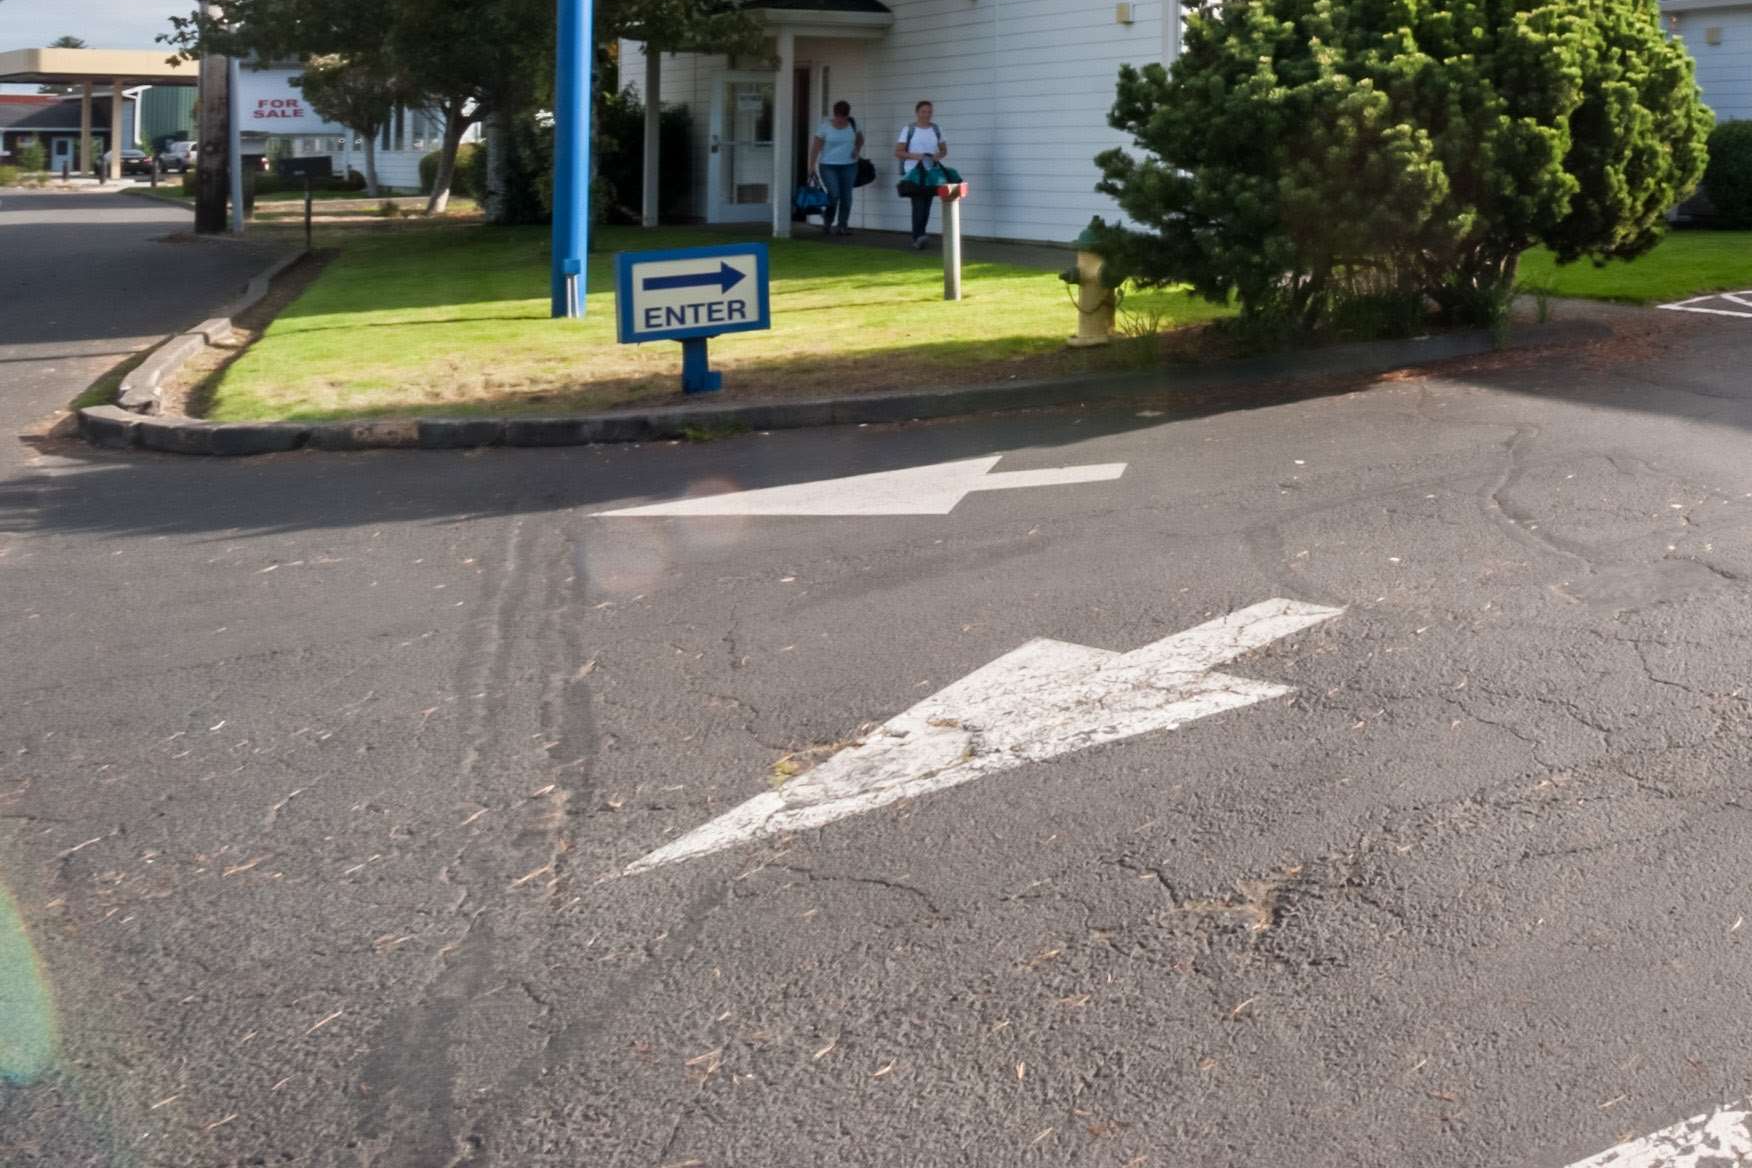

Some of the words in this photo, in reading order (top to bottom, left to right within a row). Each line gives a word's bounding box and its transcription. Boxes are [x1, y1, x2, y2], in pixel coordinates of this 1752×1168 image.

[257, 99, 299, 108] FOR
[253, 109, 305, 119] SALE
[644, 299, 747, 328] ENTER
